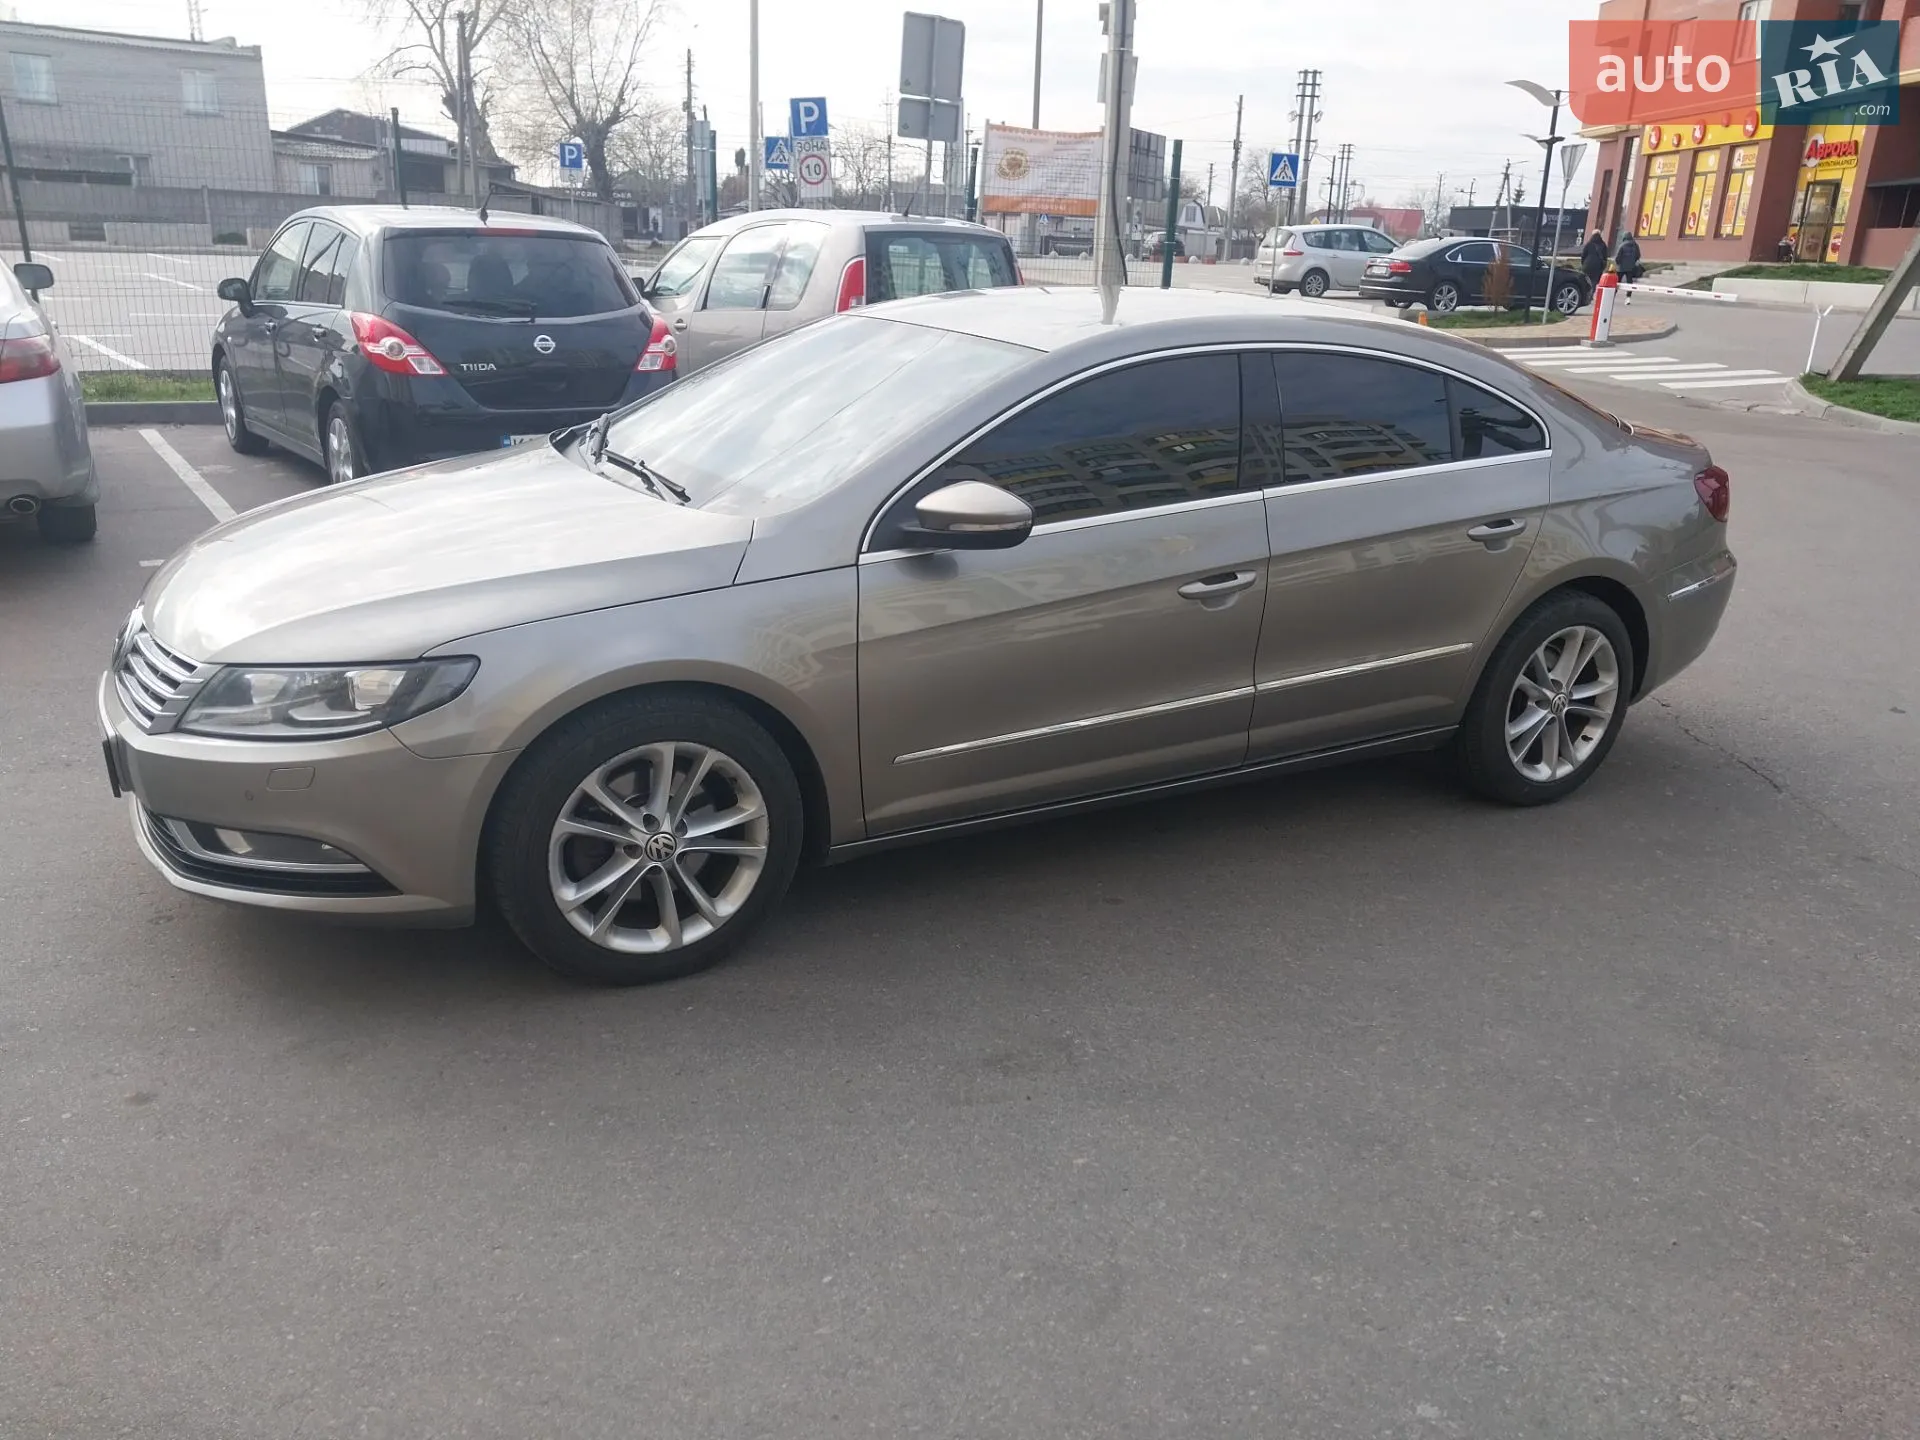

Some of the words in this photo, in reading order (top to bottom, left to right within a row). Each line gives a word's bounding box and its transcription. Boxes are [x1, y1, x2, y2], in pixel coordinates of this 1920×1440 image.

[799, 101, 820, 134] P
[564, 145, 578, 166] P
[797, 141, 827, 153] ЗОНА
[1805, 139, 1857, 160] АВРОРА
[805, 163, 821, 177] 10
[460, 363, 497, 371] TIIDA
